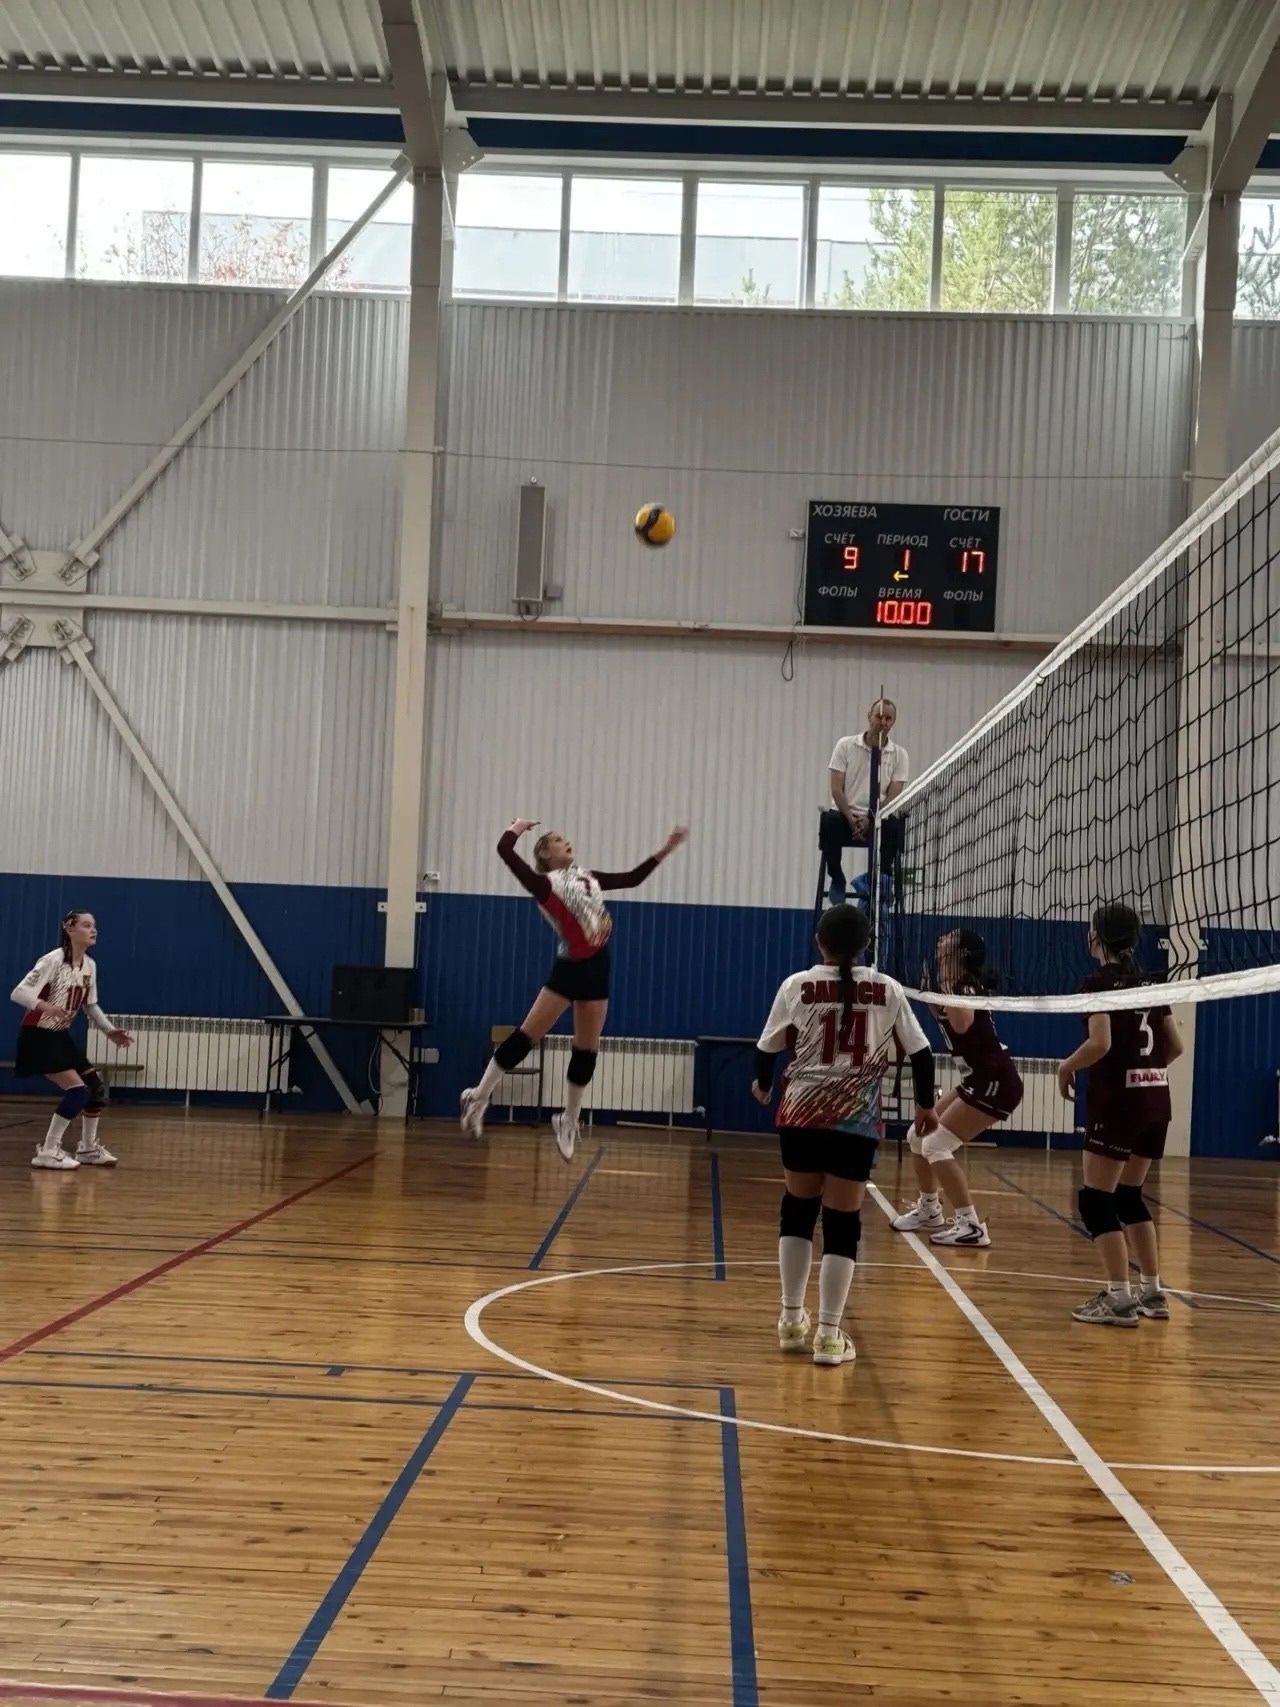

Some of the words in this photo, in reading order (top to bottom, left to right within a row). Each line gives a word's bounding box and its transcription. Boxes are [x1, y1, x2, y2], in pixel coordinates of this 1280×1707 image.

[812, 504, 878, 518] ХОЗЯЕВА
[943, 508, 990, 522] ГОСТИ
[877, 533, 929, 548] ПЕРИОД
[843, 546, 859, 570] 9
[903, 549, 911, 571] 1
[960, 551, 986, 574] 17
[818, 585, 859, 598] ФОЛЫ
[878, 586, 922, 599] ВРЕМЯ
[943, 589, 984, 602] ФОЛЫ
[801, 980, 887, 1007] ЗАСК
[819, 1009, 868, 1067] 14
[1134, 1010, 1155, 1057] 3
